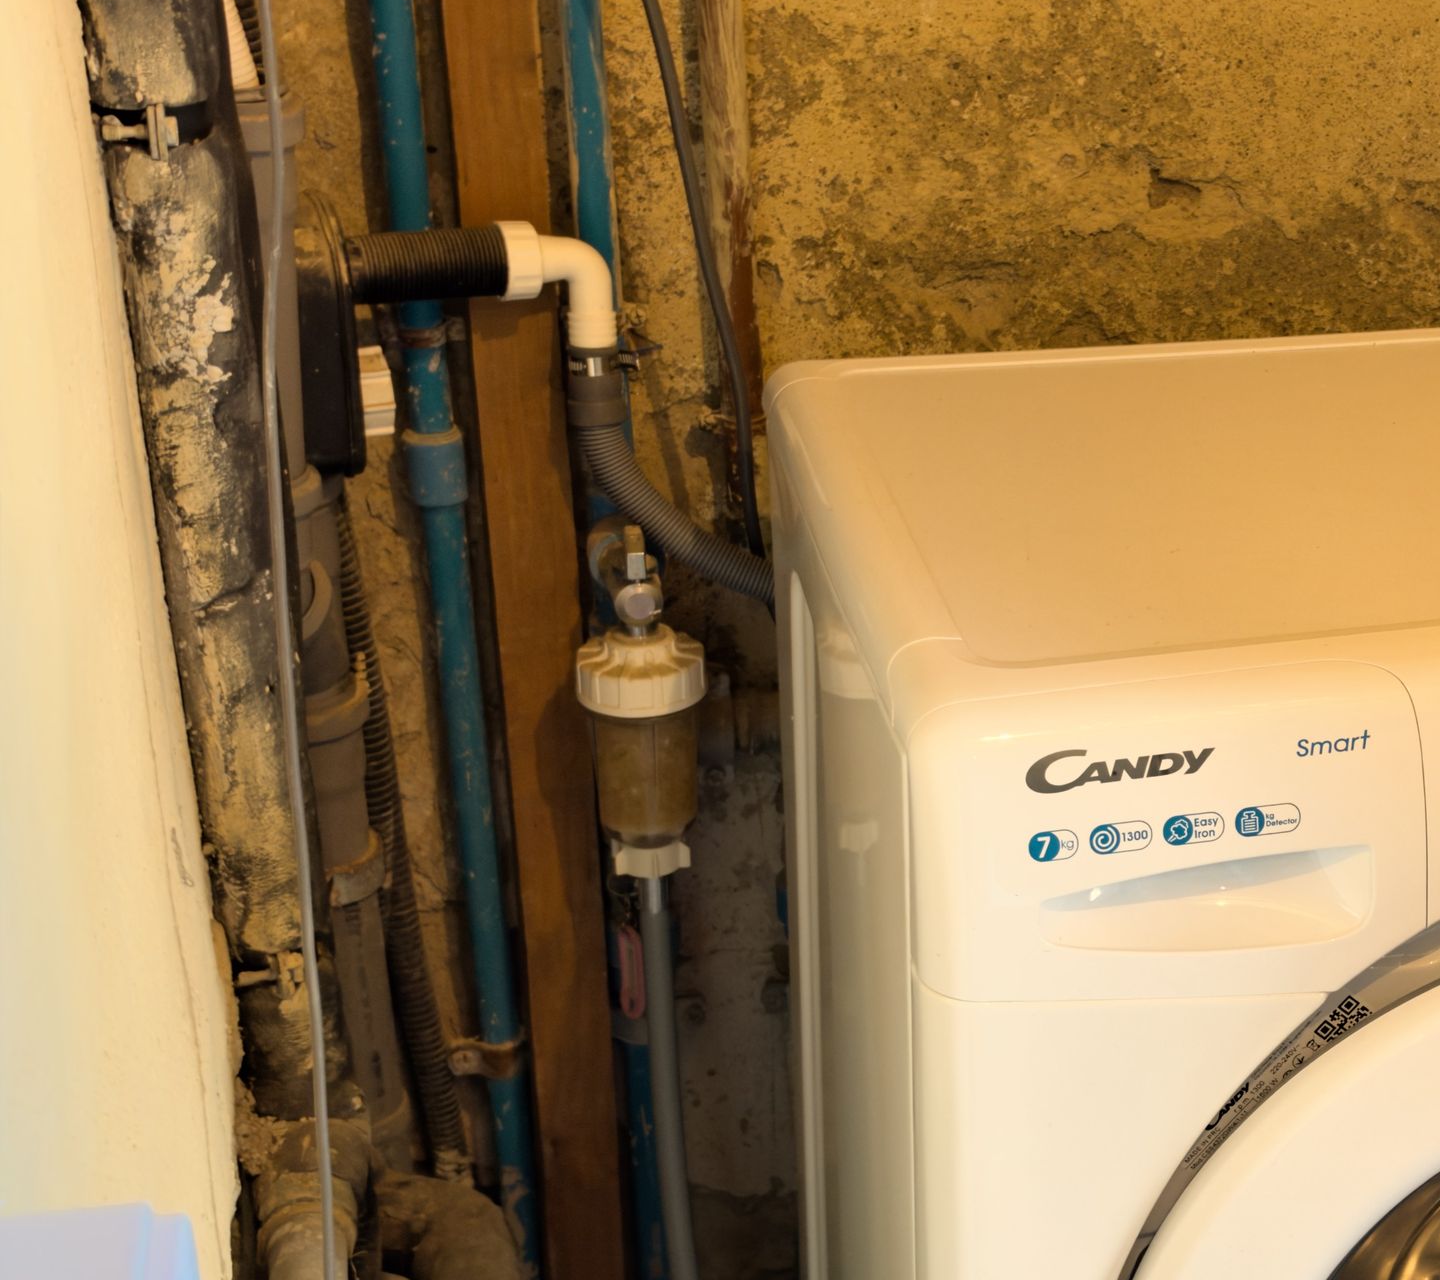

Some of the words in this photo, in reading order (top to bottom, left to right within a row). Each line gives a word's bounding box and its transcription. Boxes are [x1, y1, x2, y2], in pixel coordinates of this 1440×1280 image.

[1296, 729, 1371, 758] Smart
[1025, 747, 1216, 794] CANDY
[1194, 816, 1219, 829] Easy
[1265, 813, 1275, 821] kg
[1265, 817, 1298, 827] Detector
[1122, 830, 1148, 843] 1300
[1194, 828, 1216, 839] Iron
[1037, 836, 1051, 859] 7
[1060, 838, 1074, 851] kg
[1251, 1080, 1265, 1095] 1300
[1185, 1145, 1202, 1164] MADE
[1201, 1138, 1209, 1147] IN
[1207, 1127, 1220, 1139] PRC
